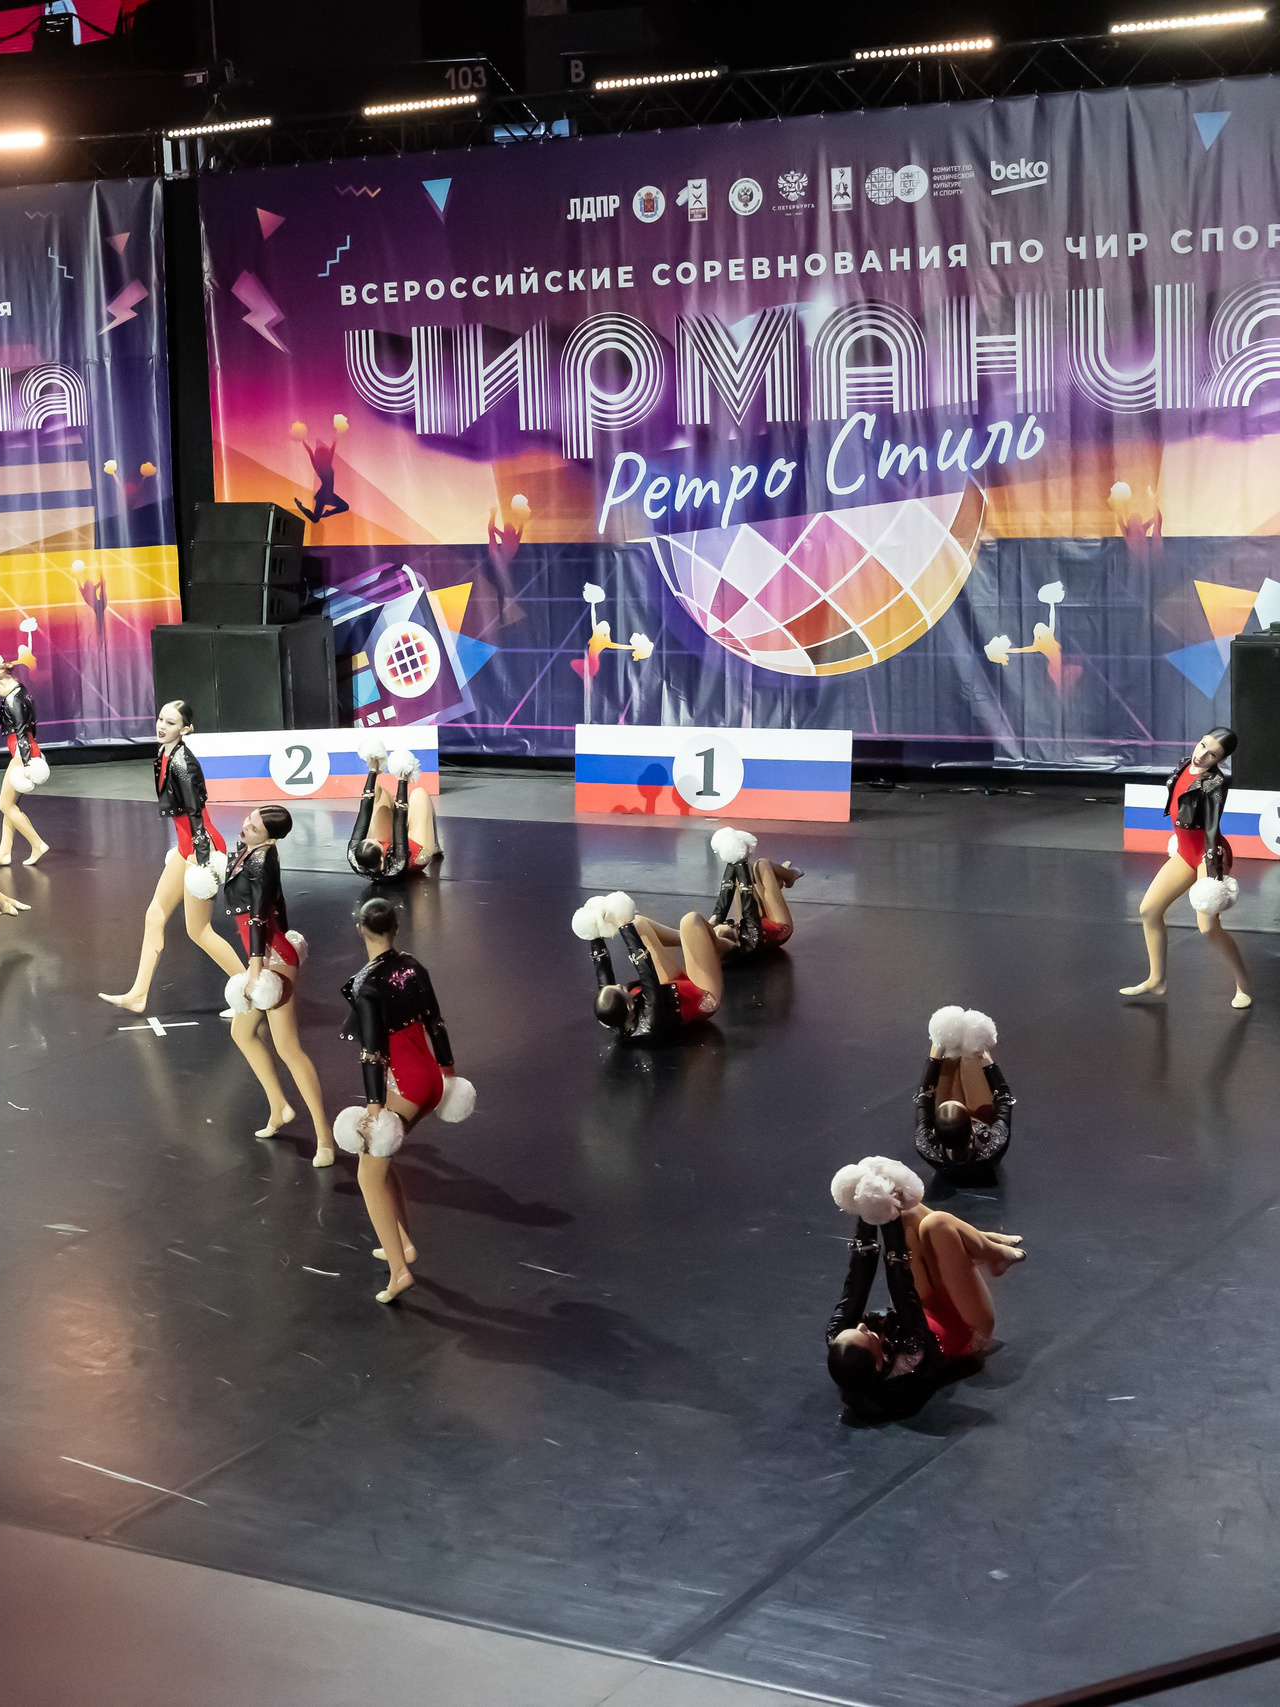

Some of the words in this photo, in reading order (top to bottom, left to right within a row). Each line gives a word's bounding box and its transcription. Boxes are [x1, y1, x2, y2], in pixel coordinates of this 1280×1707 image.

[444, 66, 487, 91] 103
[932, 165, 961, 173] КОМИТЕТ
[932, 171, 975, 181] ФИЗИЧЕСКОЙ
[990, 157, 1049, 181] beko
[933, 181, 962, 189] КУЛЬТУРЕ
[939, 188, 964, 197] СПОРТУ
[567, 194, 620, 222] ЛДПР
[340, 266, 634, 306] ВСЕРОССИЙСКИЕ
[651, 243, 968, 285] СОРЕВНОВАНИЯ
[990, 238, 1045, 266] ПО
[1065, 232, 1148, 260] ЧИР
[598, 451, 798, 535] Ретро
[825, 411, 1045, 495] Стиль
[285, 745, 314, 785] 2
[695, 747, 721, 797] 1
